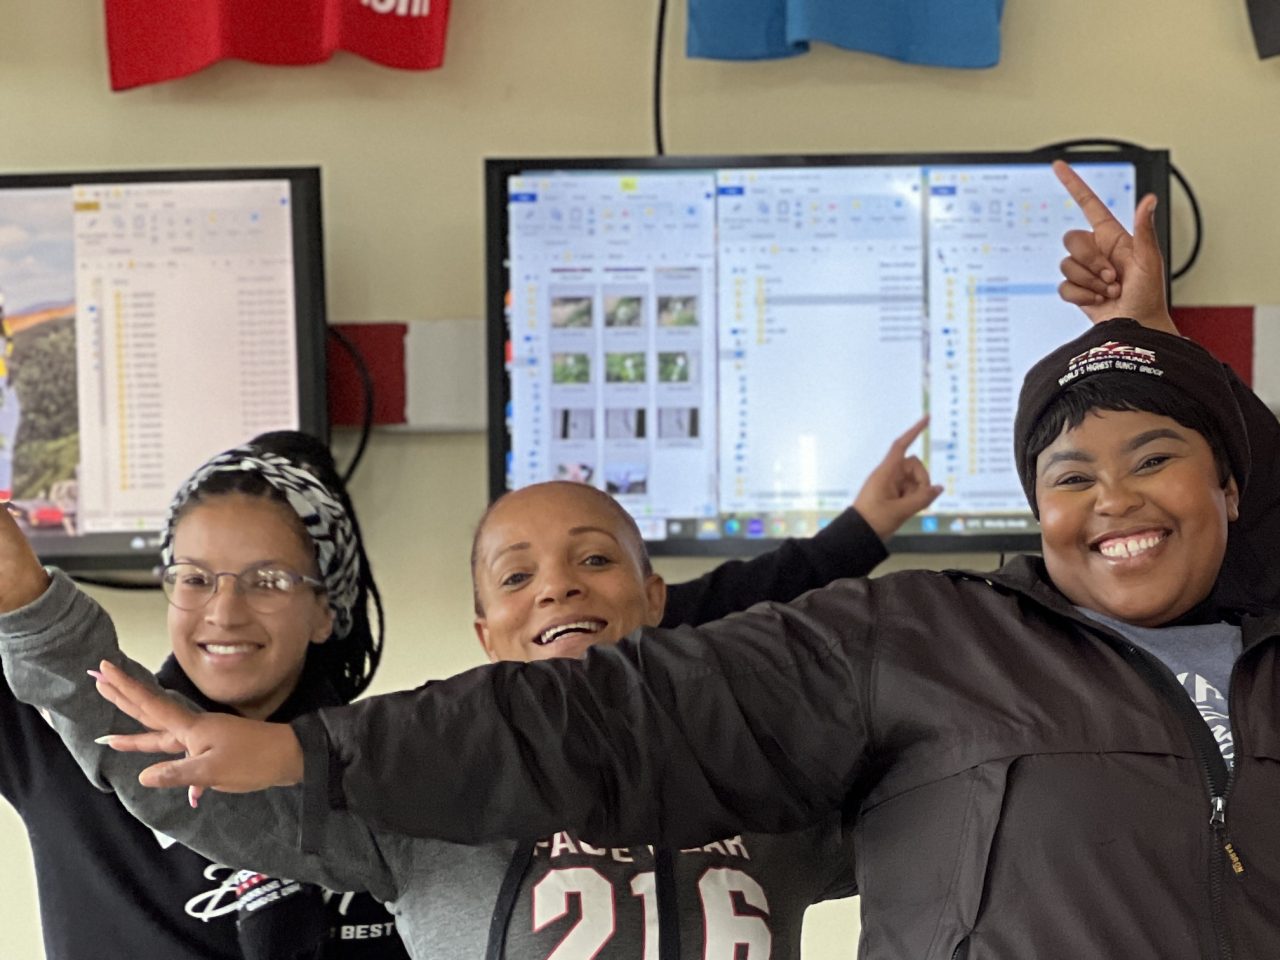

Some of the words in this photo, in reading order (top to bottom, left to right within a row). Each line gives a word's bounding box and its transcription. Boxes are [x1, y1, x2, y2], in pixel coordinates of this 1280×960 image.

[1058, 366, 1085, 386] WORLD'S
[1086, 361, 1113, 373] HIGHEST
[340, 922, 395, 940] BEST
